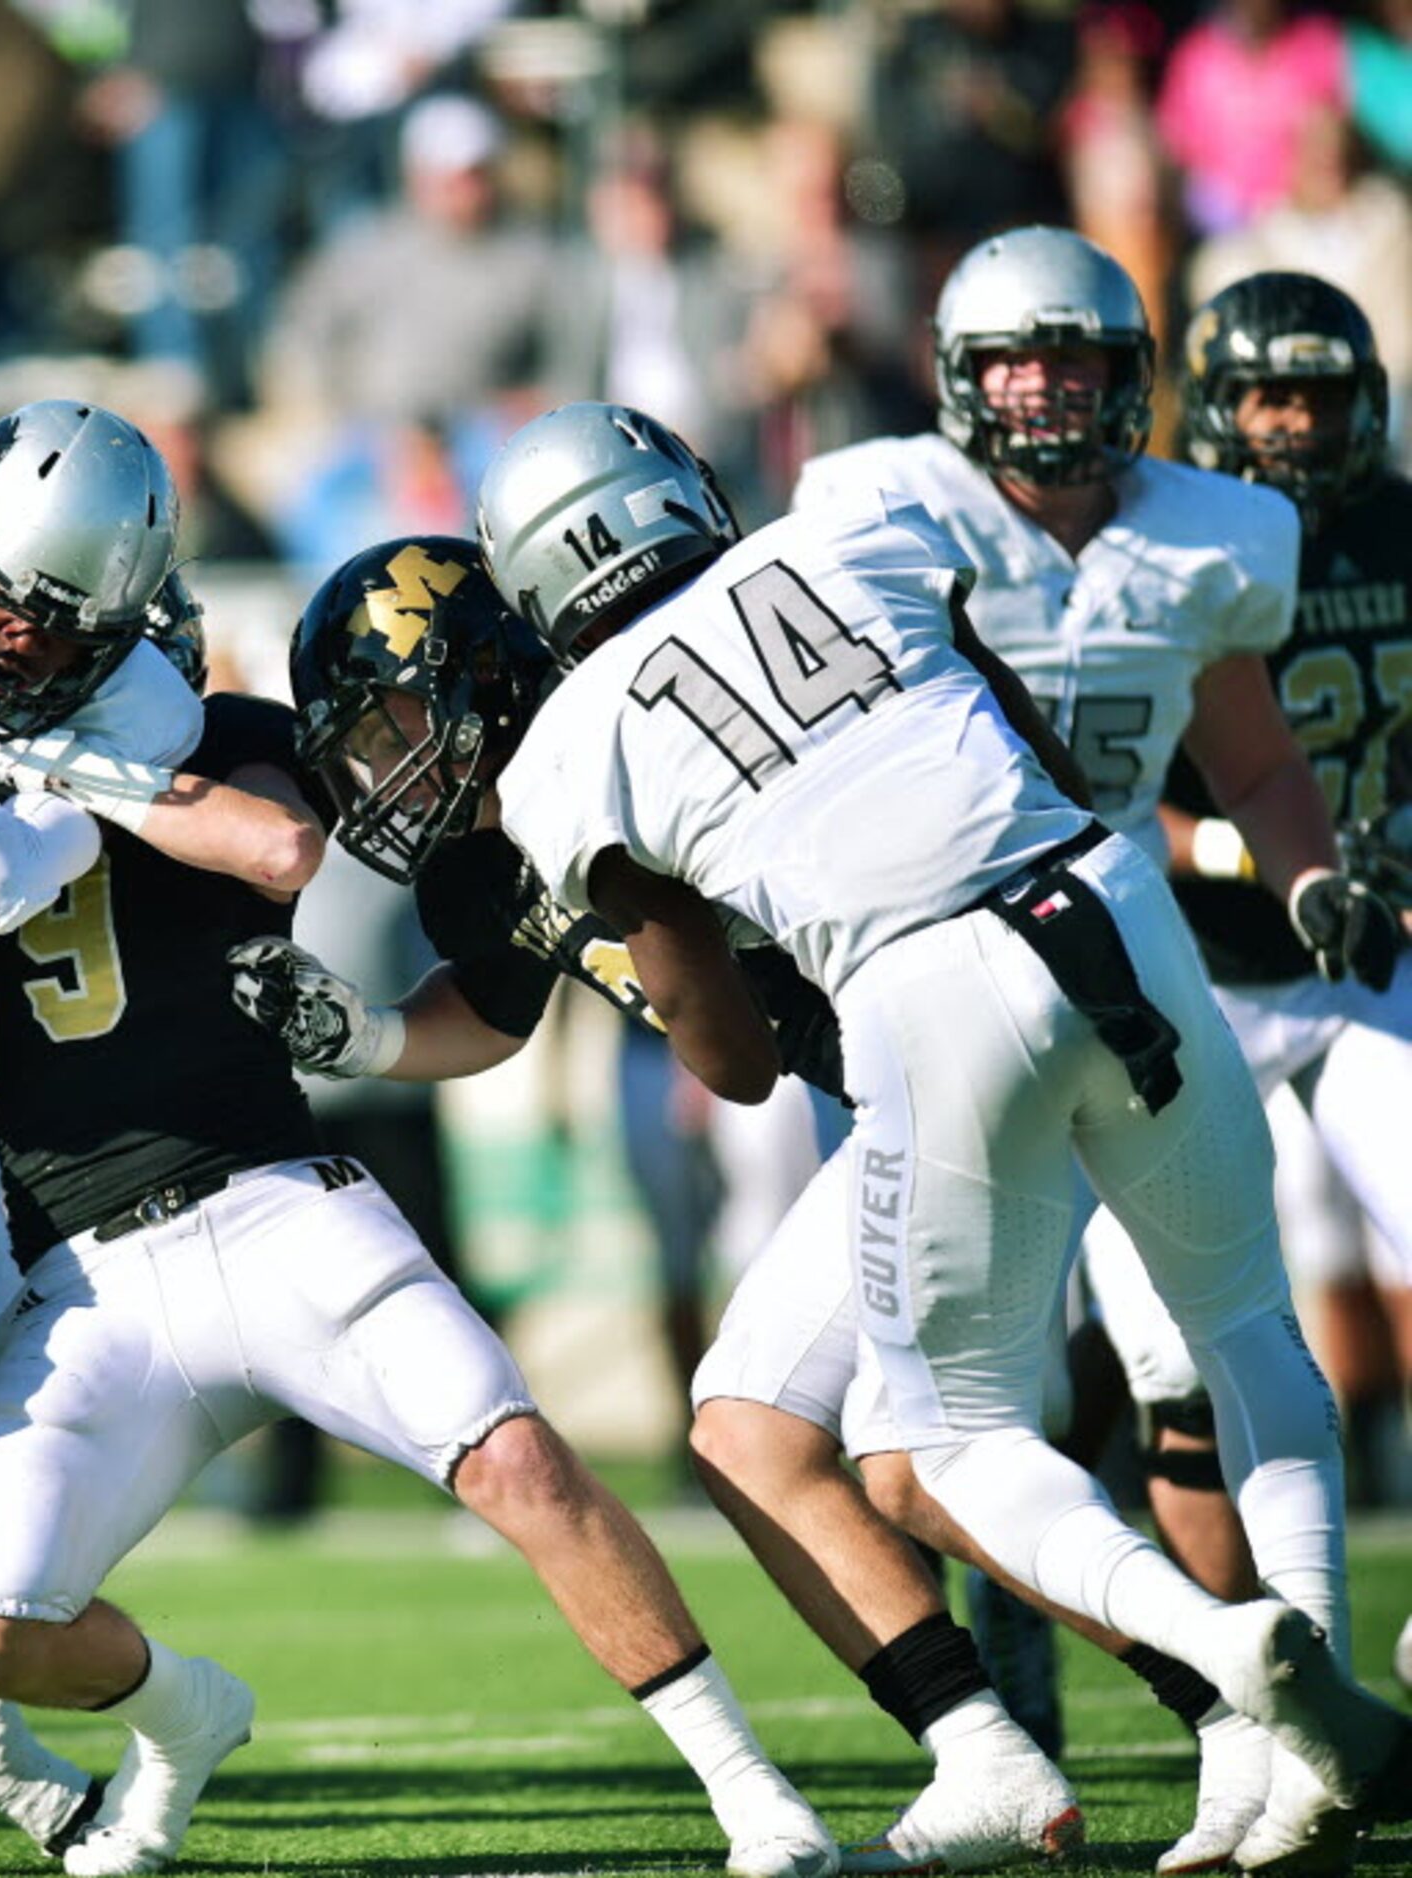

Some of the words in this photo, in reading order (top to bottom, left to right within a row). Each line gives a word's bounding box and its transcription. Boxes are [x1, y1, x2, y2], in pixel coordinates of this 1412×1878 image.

[563, 512, 622, 573] 14
[574, 548, 664, 615] Riddell
[344, 544, 470, 662] M
[626, 557, 905, 794] 14
[1031, 694, 1156, 810] 5
[303, 1157, 366, 1193] M
[860, 1147, 906, 1319] GUYER
